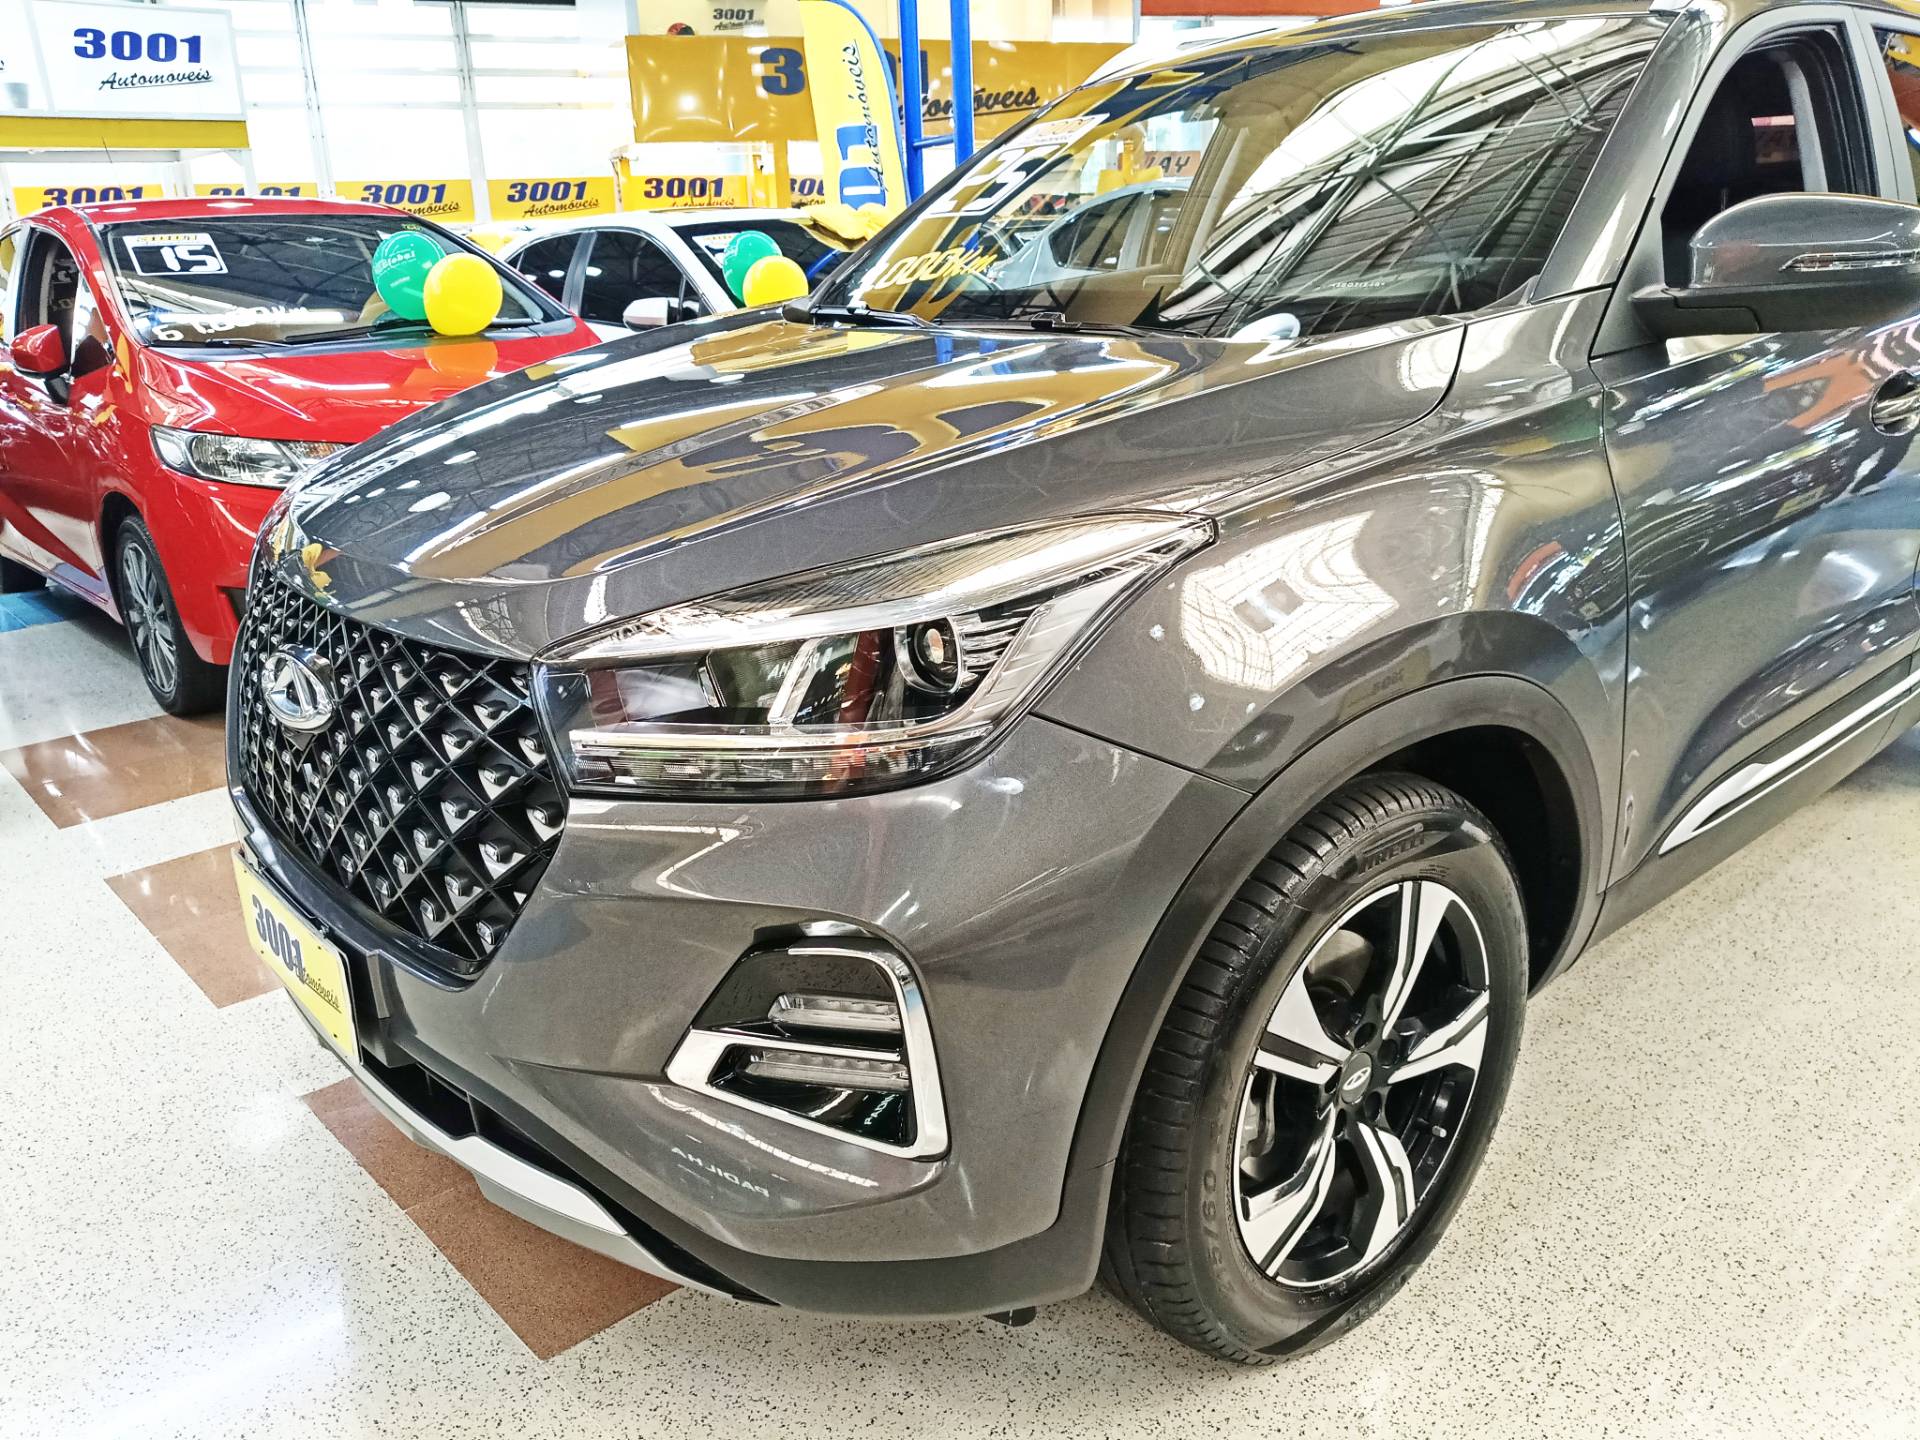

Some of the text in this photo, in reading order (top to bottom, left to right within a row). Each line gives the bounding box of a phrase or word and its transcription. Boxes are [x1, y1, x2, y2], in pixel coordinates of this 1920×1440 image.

[713, 8, 754, 20] 3001
[74, 27, 201, 63] 3001
[361, 183, 446, 205] 3001
[507, 181, 587, 203] 3001
[644, 177, 724, 199] 3001
[522, 197, 599, 218] Automóveis
[160, 245, 221, 272] 15
[252, 894, 305, 985] 3001
